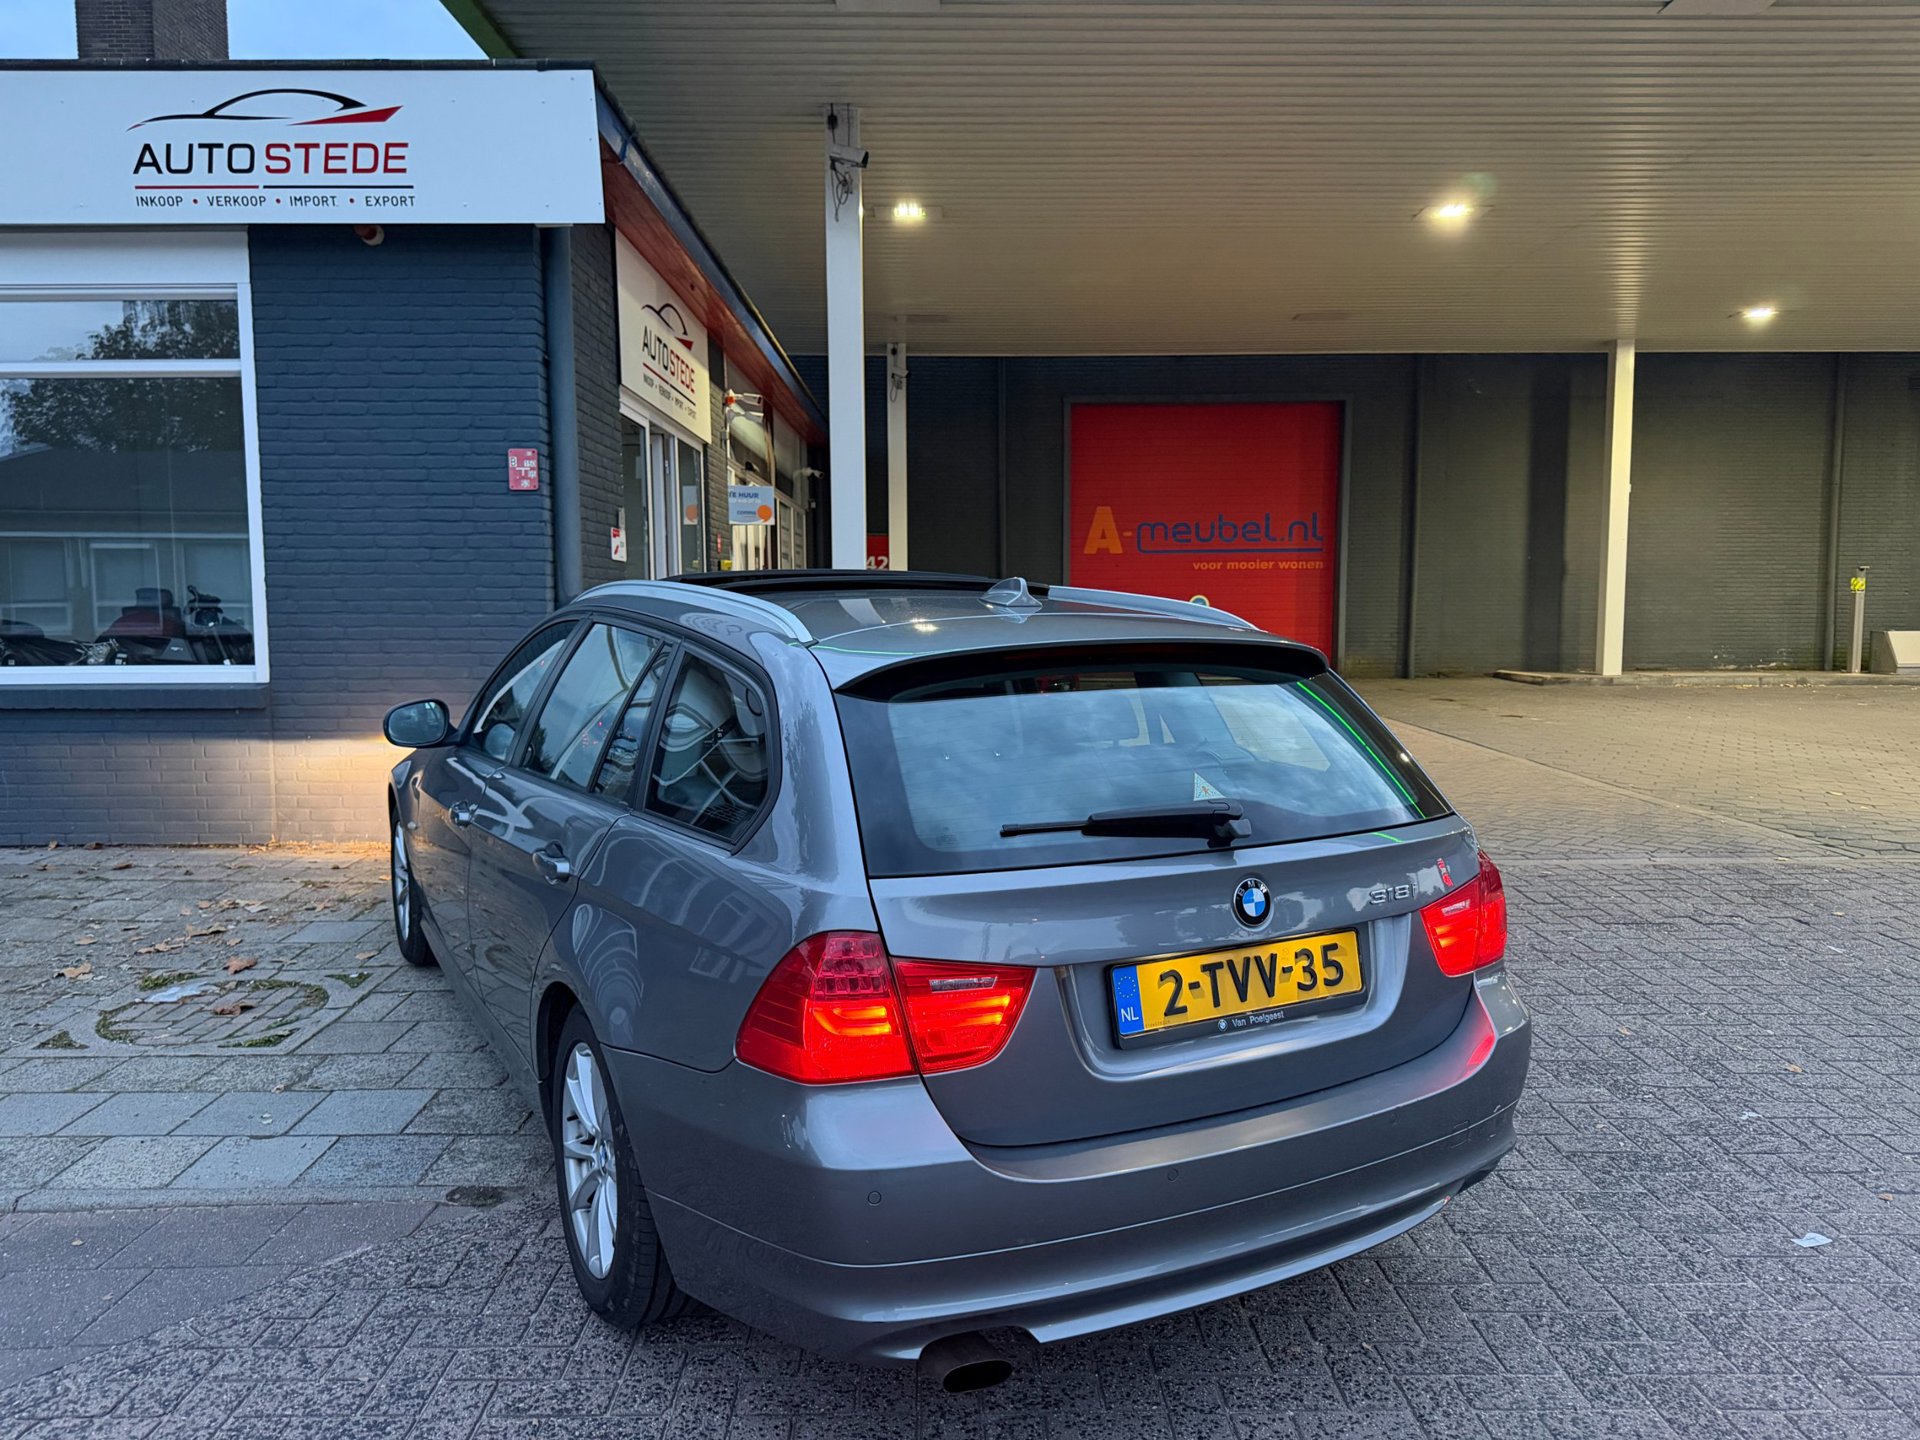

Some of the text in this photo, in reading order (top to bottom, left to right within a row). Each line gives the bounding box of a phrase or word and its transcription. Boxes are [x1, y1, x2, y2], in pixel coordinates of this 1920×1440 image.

[135, 195, 416, 207] INKOOP VERKOOP IMPORT EXPORT
[1083, 506, 1324, 554] A-meubel.nl
[1192, 558, 1324, 570] voor mooier wonen
[1237, 880, 1268, 897] BMW
[1369, 882, 1419, 905] 318i
[1159, 943, 1344, 1017] 2-TVV-35
[1120, 1007, 1140, 1023] NL
[1231, 1010, 1285, 1028] Van Poelgeest
